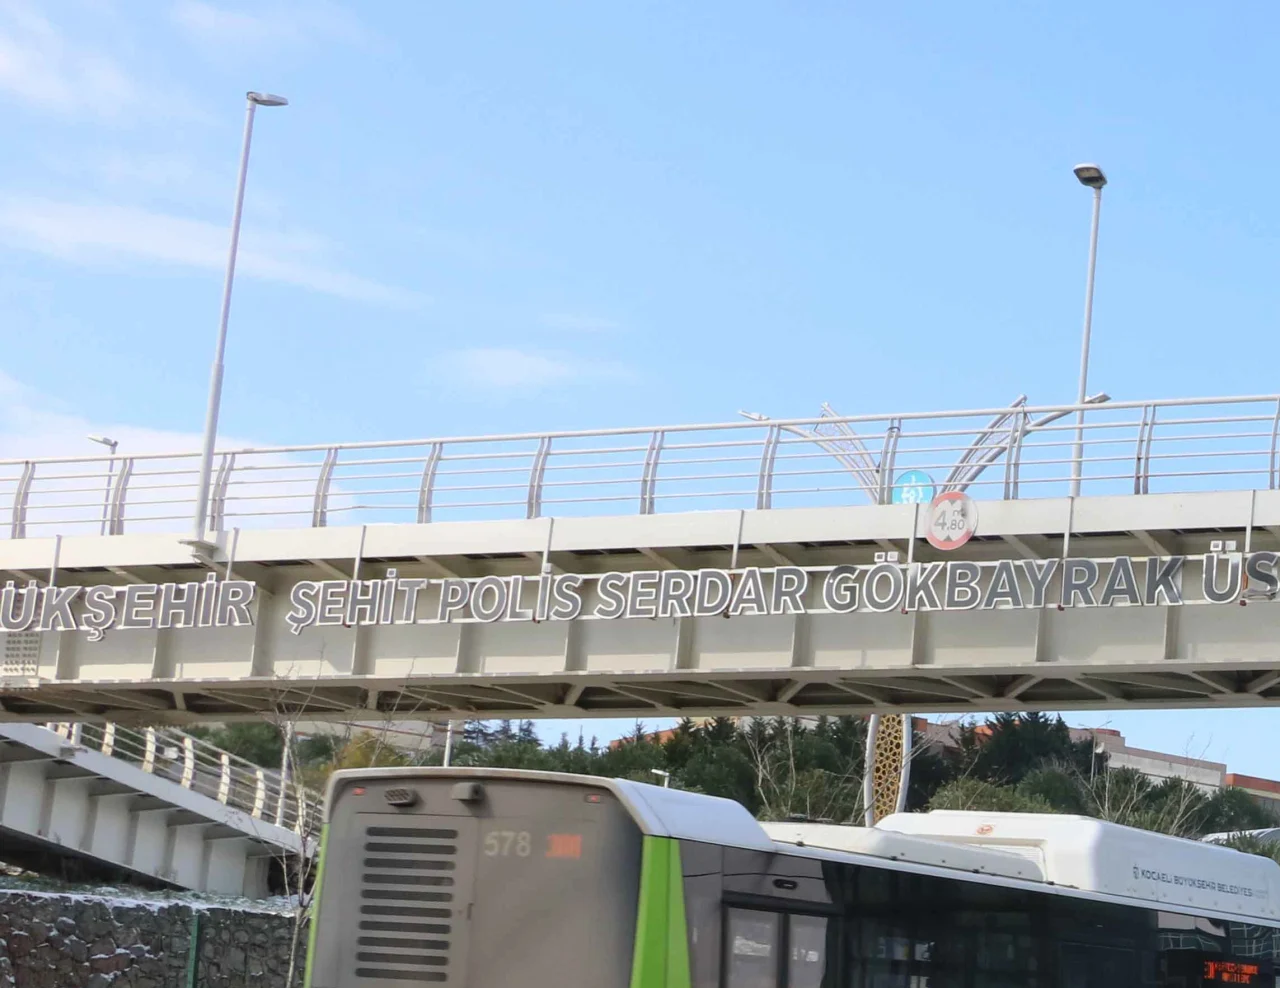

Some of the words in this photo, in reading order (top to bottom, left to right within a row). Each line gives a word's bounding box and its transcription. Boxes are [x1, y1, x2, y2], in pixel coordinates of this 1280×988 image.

[1, 572, 254, 641] ÜKŞEHİR
[285, 568, 427, 635] ŞEHİT
[438, 563, 583, 623] POLİS
[594, 566, 808, 619] SERDAR
[823, 551, 1186, 613] GÖKBAYRAK
[484, 831, 532, 857] 578
